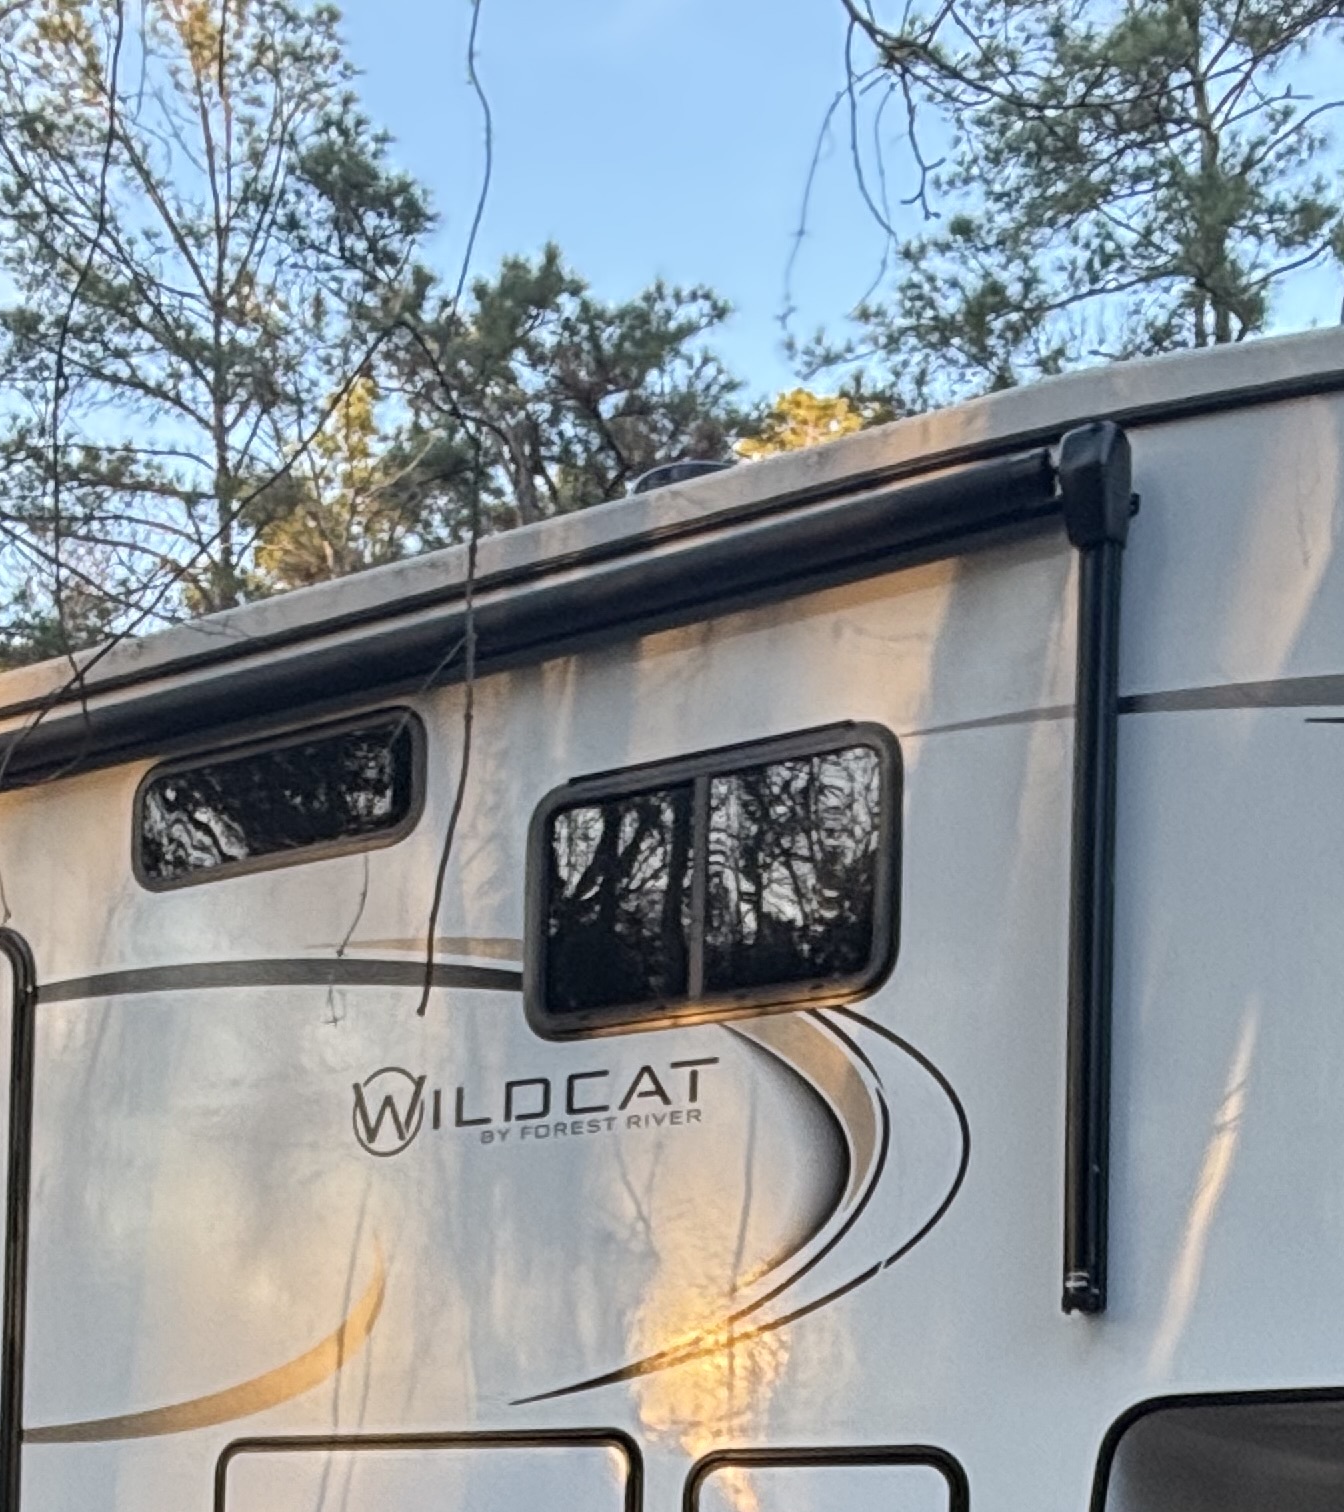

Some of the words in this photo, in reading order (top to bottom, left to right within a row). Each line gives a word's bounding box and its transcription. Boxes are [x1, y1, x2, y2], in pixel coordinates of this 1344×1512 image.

[352, 1057, 720, 1145] WILDCAT
[480, 1128, 511, 1144] BY
[520, 1116, 617, 1139] FOREST
[626, 1108, 703, 1130] RIVER
